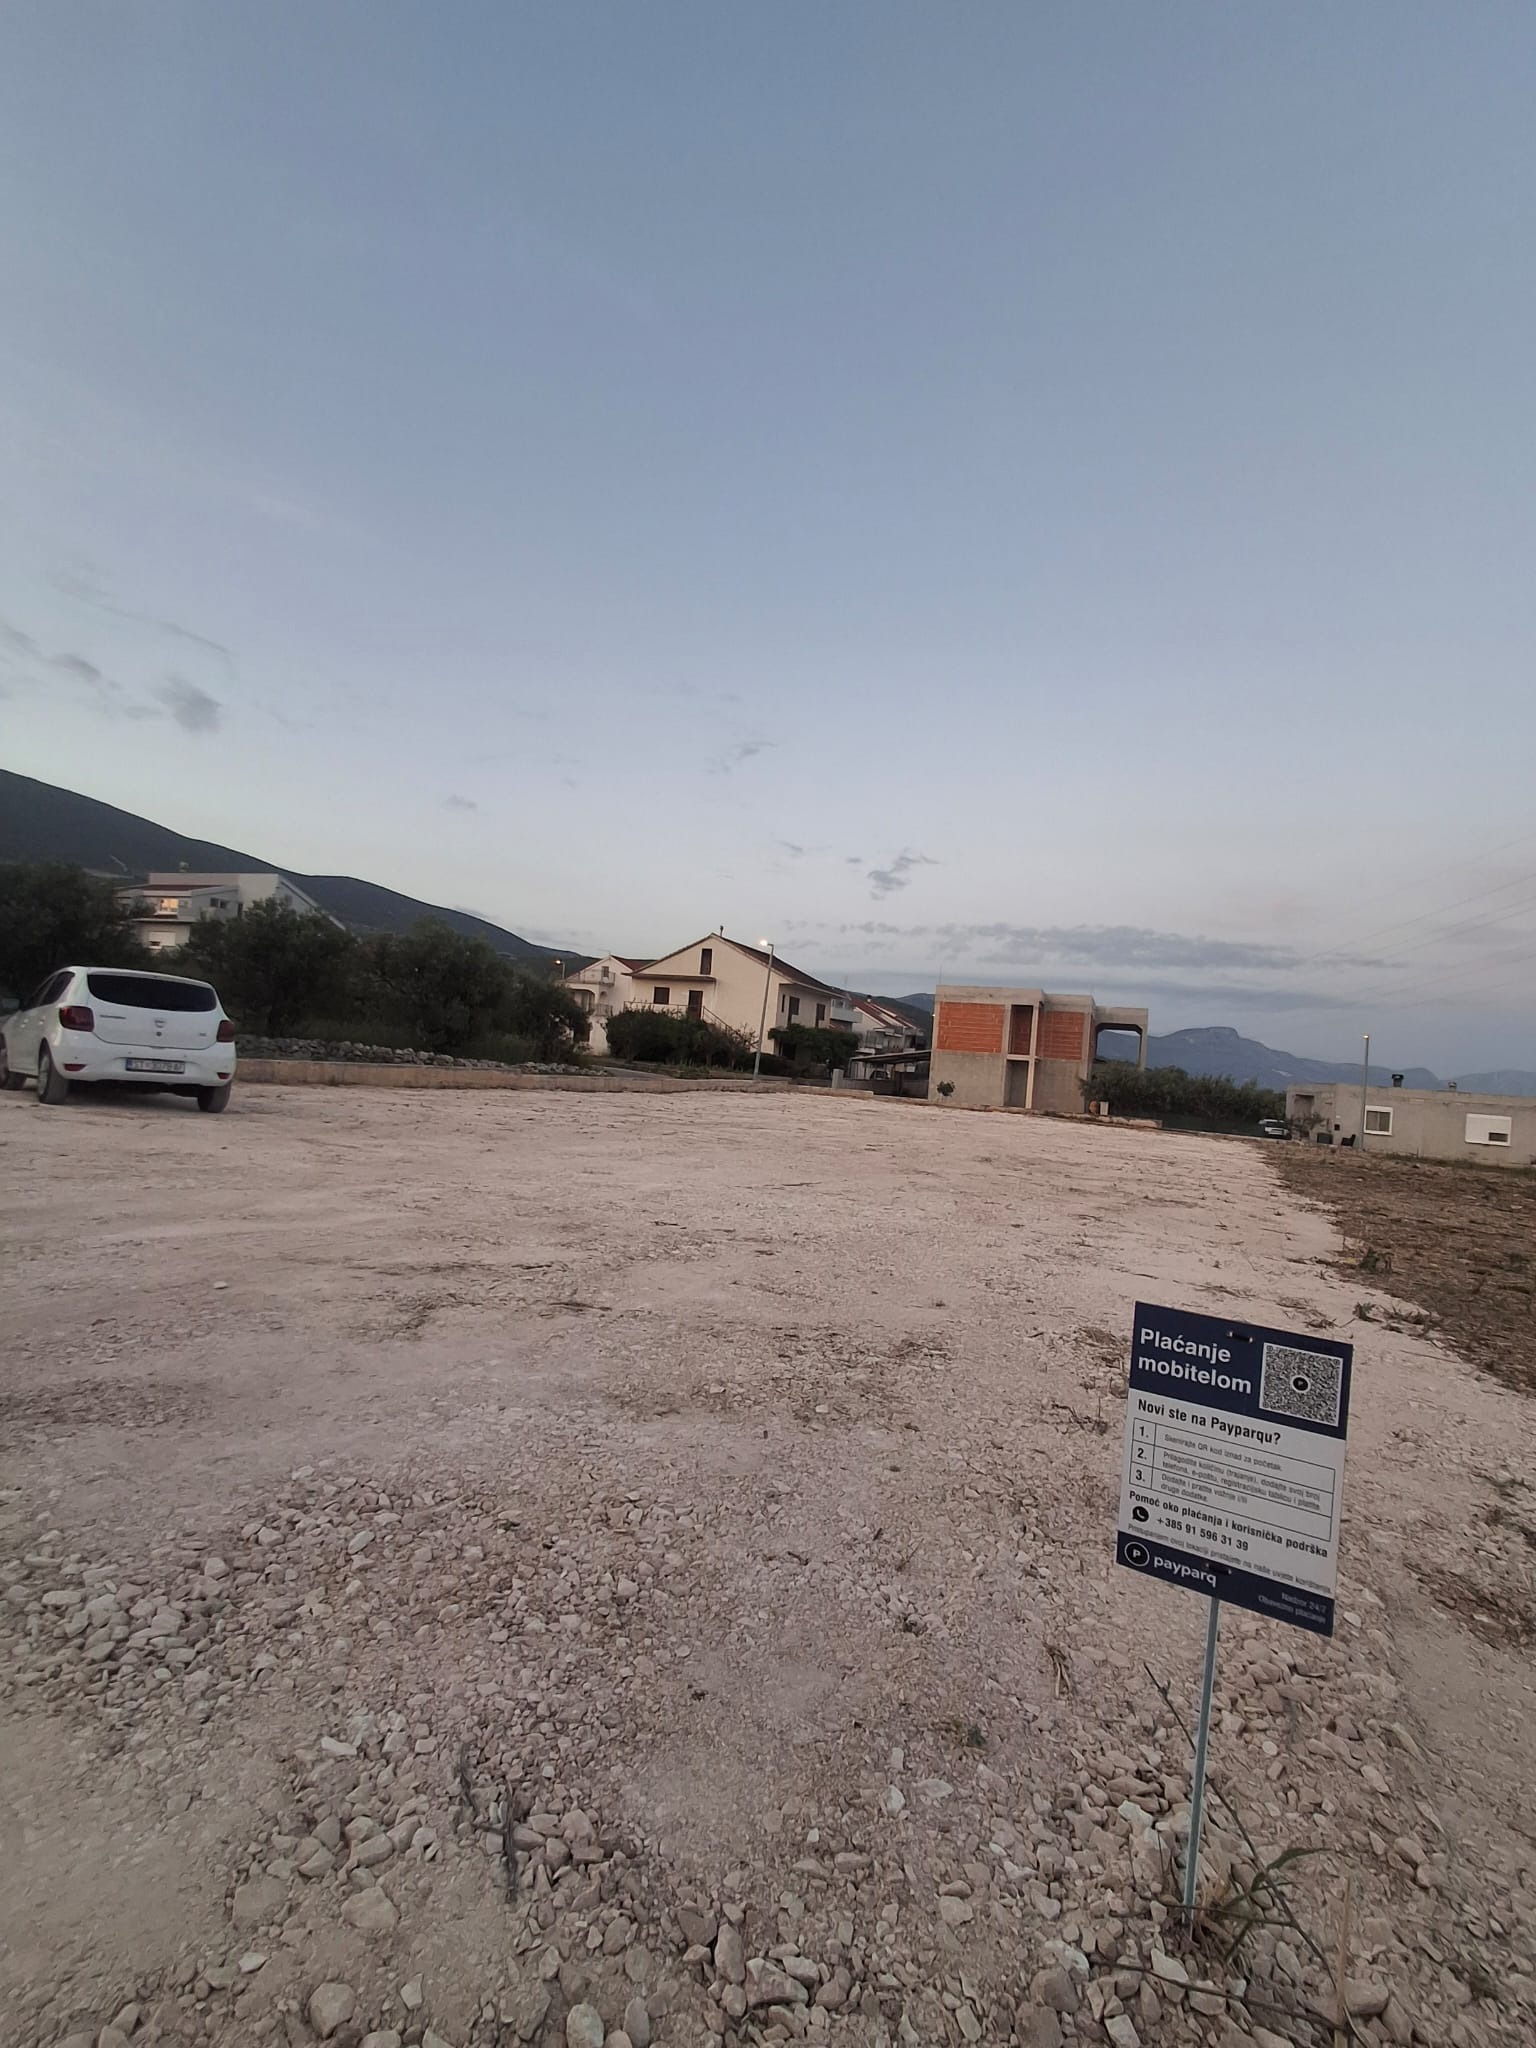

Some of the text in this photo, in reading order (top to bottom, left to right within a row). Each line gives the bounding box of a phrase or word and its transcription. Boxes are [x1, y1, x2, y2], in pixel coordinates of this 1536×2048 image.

[1140, 1328, 1231, 1364] Plaćanje
[1138, 1357, 1251, 1394] mobitelom
[1138, 1398, 1281, 1445] Novi ste na Payparqu?
[1137, 1447, 1148, 1460] 2.
[1139, 1426, 1149, 1438] 1.
[1198, 1442, 1208, 1451] QR
[1210, 1446, 1222, 1456] kod
[1135, 1469, 1146, 1482] 3.
[1129, 1490, 1329, 1558] Pomoć oko plaćanja i korisnička podrška
[1157, 1517, 1249, 1551] +385 91 596 31 39
[1132, 1548, 1217, 1588] P payparq
